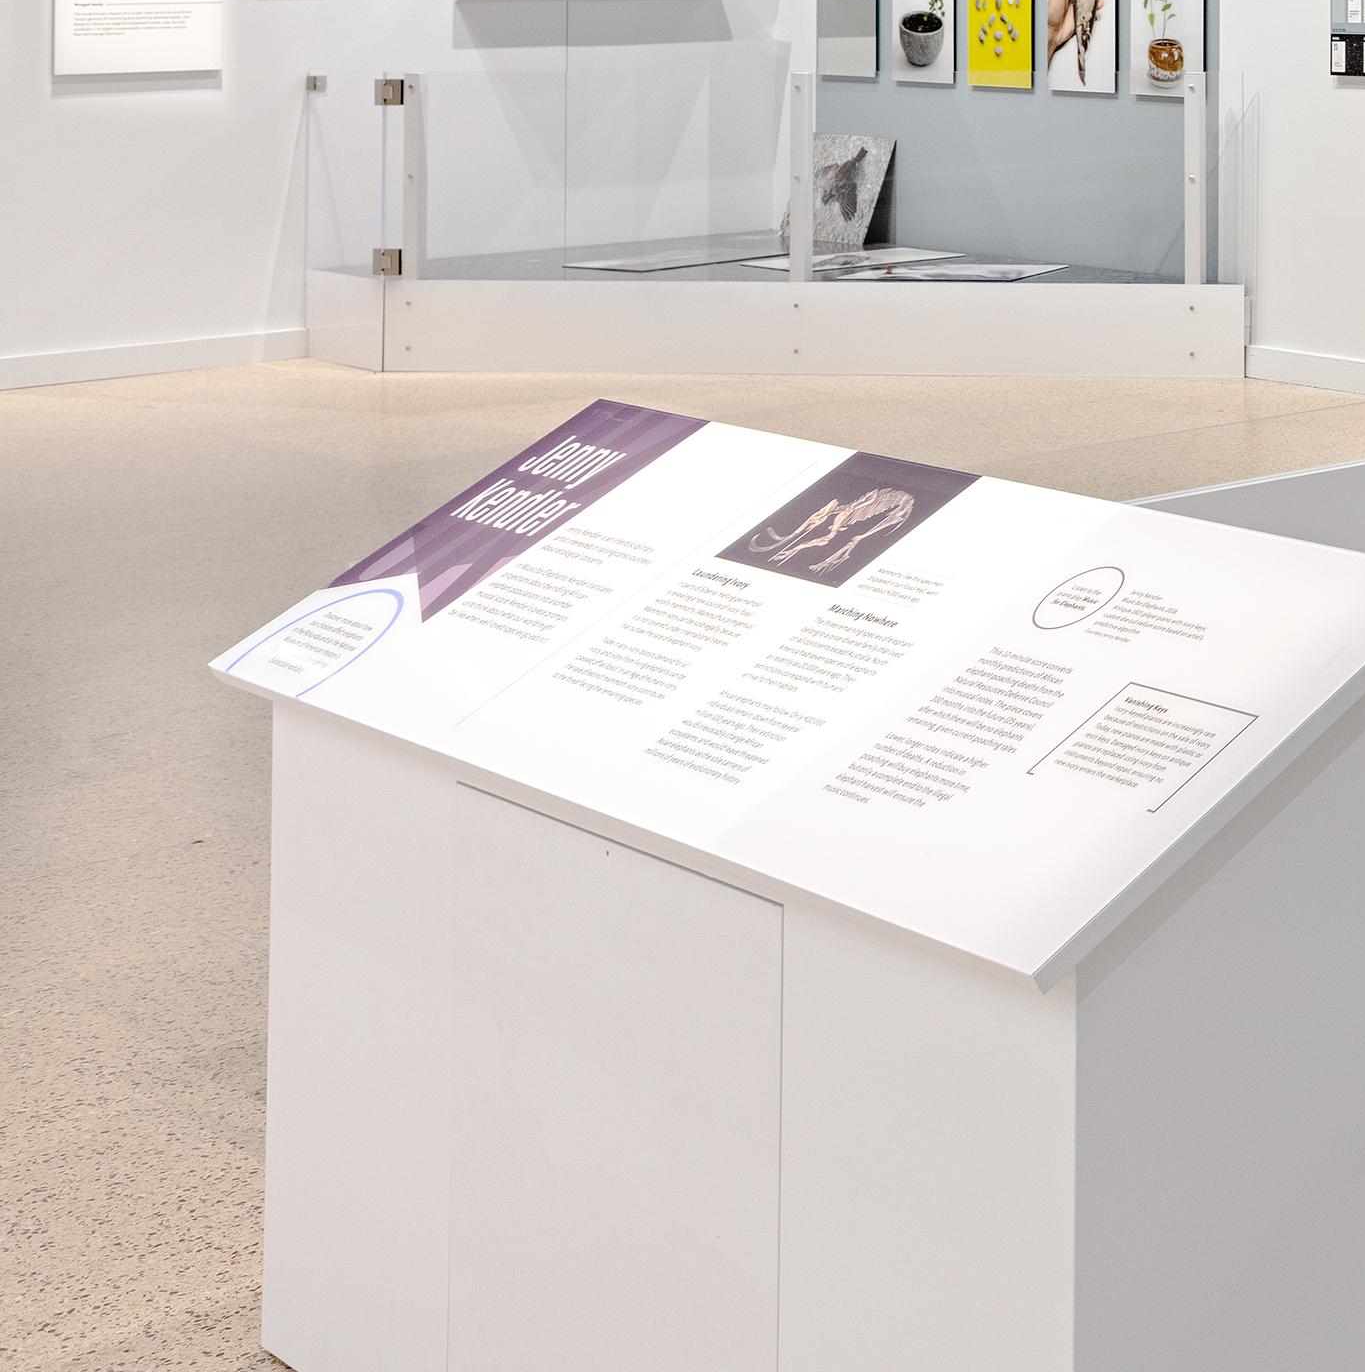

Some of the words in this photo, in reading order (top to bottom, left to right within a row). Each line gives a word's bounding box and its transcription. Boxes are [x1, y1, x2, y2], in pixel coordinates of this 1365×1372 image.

[517, 435, 627, 489] Jenny
[450, 478, 582, 536] Kendler
[692, 569, 731, 585] Laundering
[730, 578, 750, 590] Ivory
[828, 604, 865, 620] Marching
[862, 613, 898, 627] Nowhere
[1124, 697, 1155, 710] Vanishing
[1153, 705, 1168, 713] Keys
